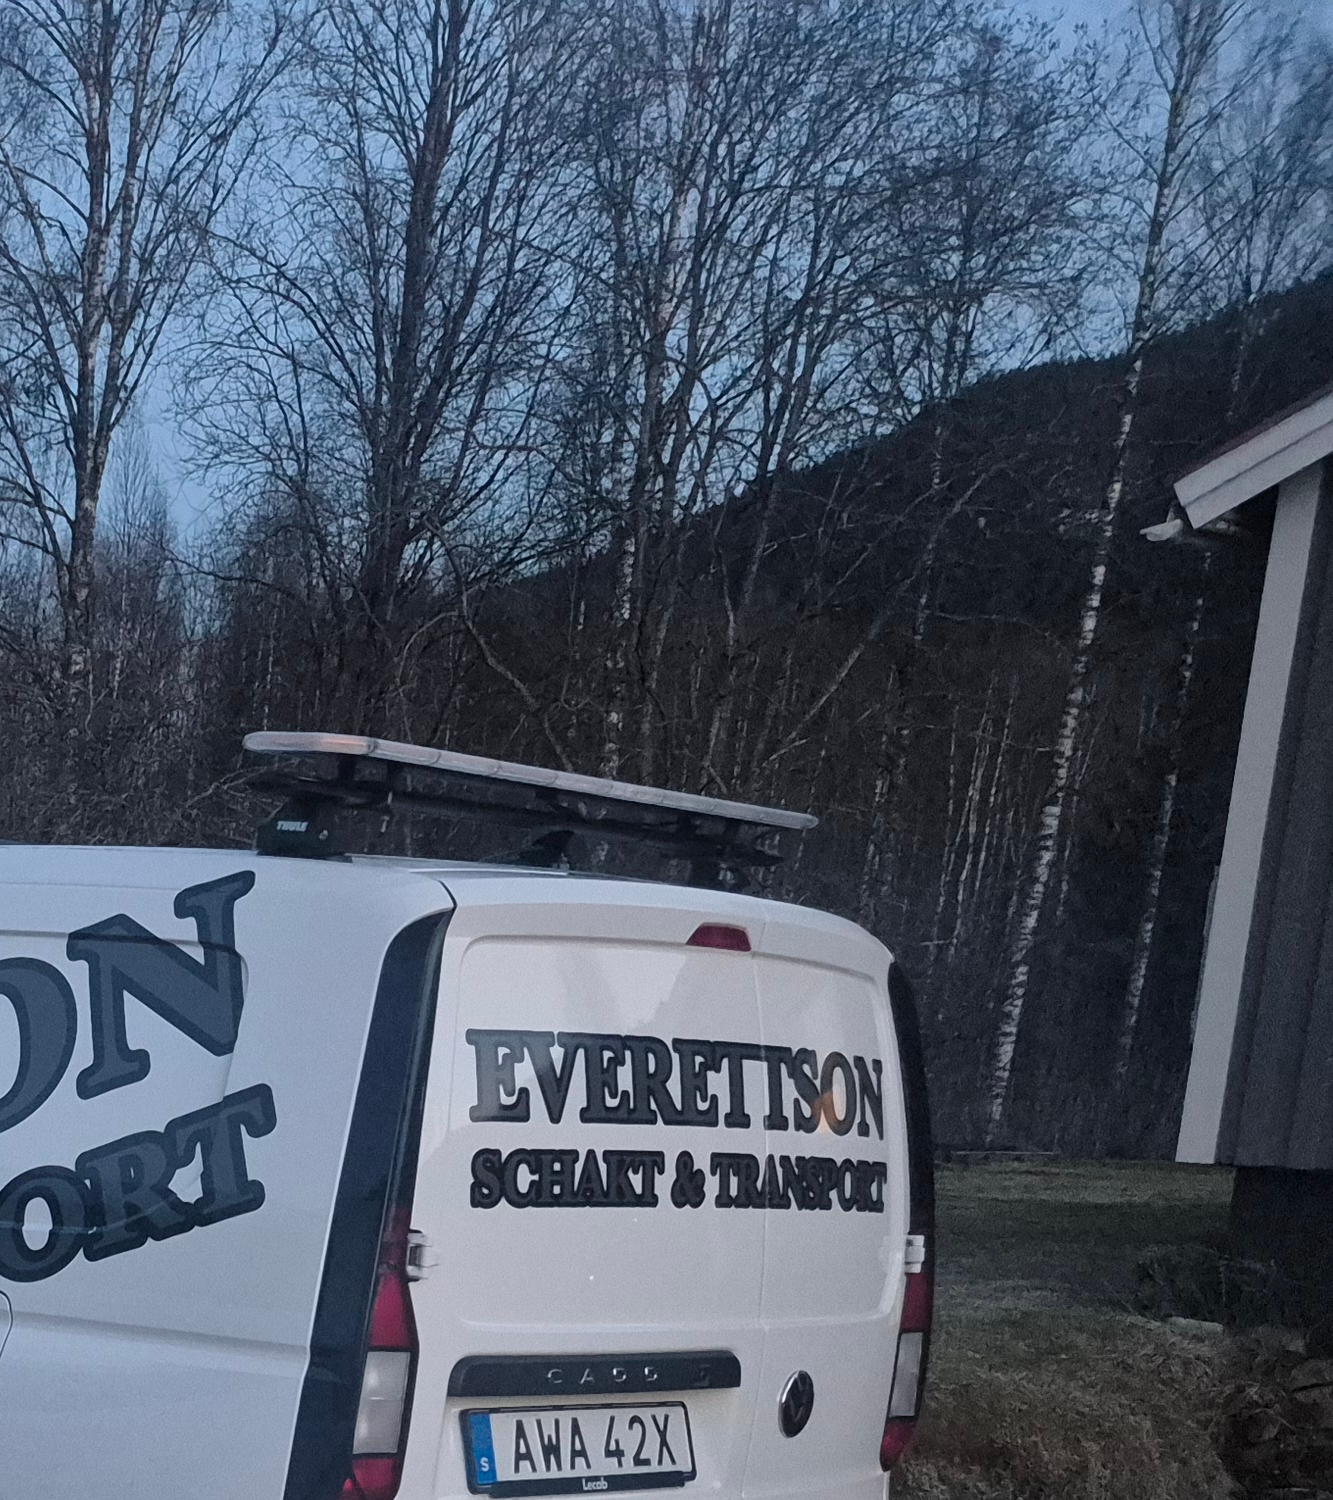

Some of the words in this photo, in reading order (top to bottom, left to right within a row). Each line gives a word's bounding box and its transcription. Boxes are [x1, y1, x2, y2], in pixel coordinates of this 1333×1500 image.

[465, 1027, 884, 1141] EVERETTSON
[470, 1148, 665, 1209] SCHAKT
[671, 1150, 706, 1209] &
[710, 1152, 887, 1213] TRANSPORT
[480, 1457, 490, 1472] S
[514, 1417, 592, 1474] AWA
[604, 1414, 677, 1469] 42X
[582, 1476, 608, 1490] Lecab
